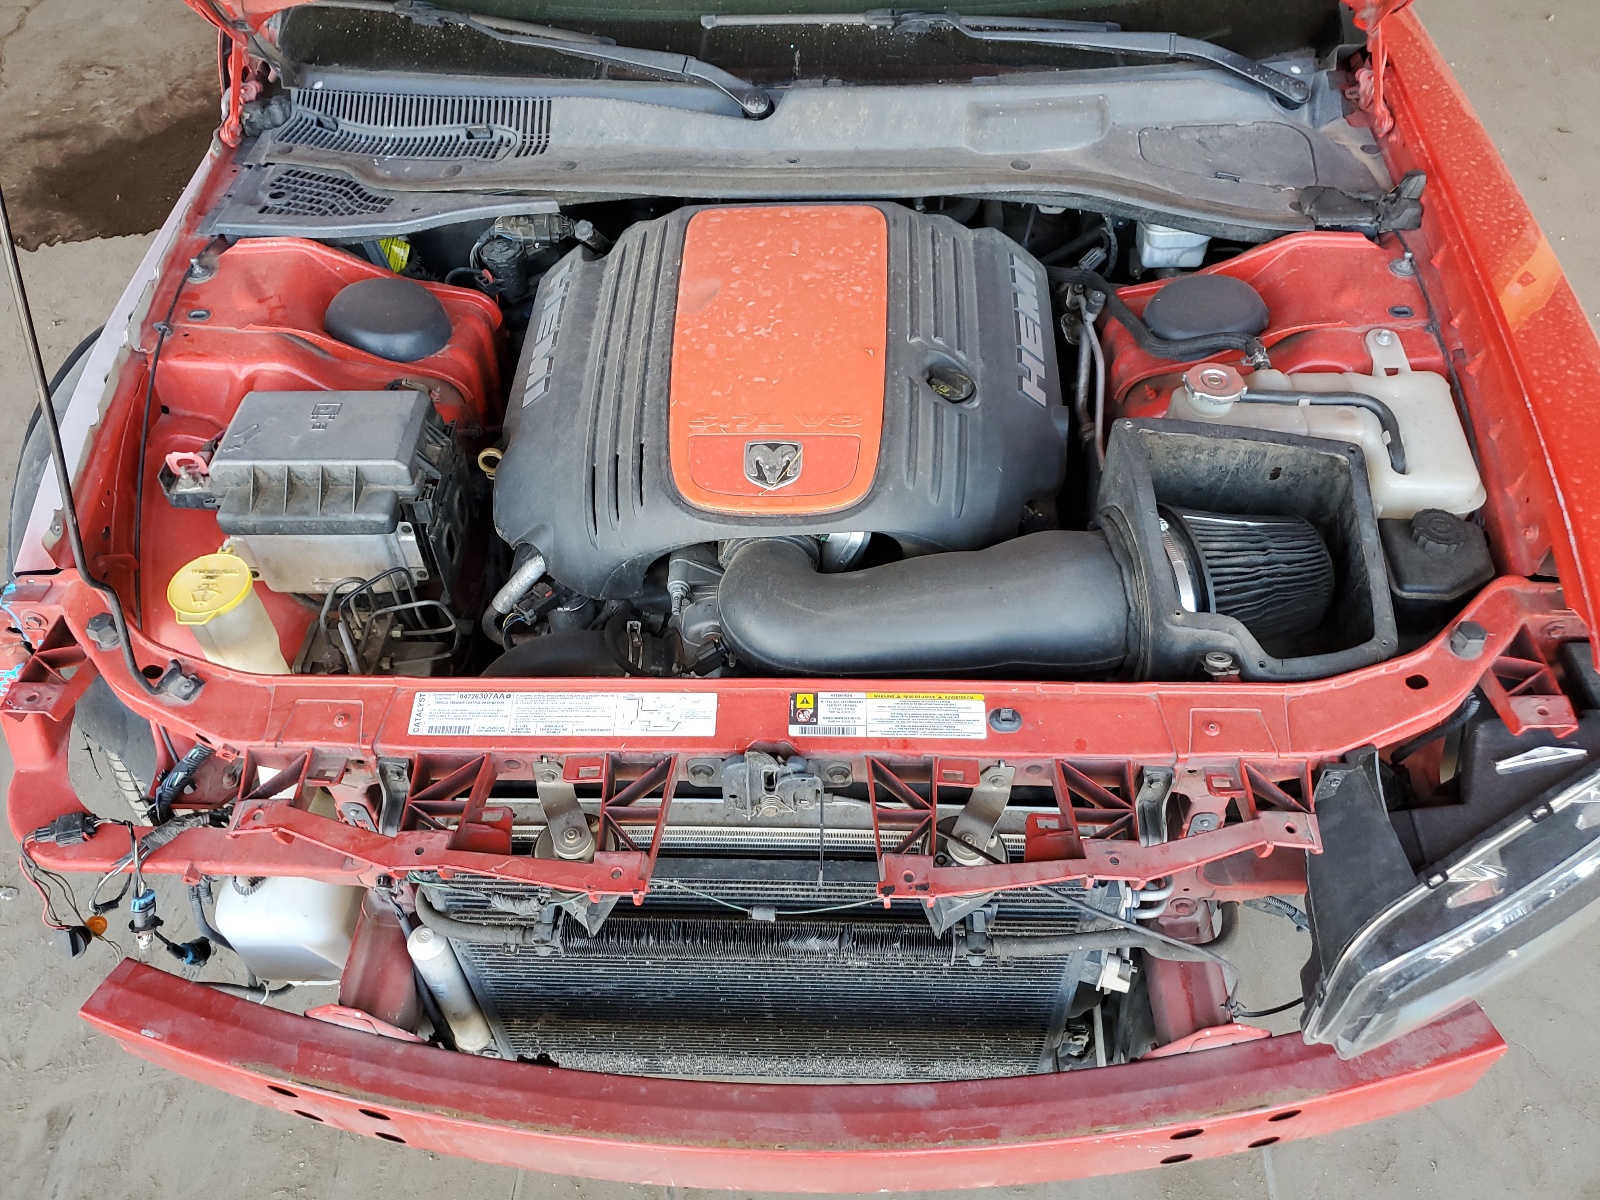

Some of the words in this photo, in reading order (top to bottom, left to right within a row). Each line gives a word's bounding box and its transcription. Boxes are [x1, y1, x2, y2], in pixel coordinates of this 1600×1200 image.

[522, 260, 575, 408] HEMI
[1009, 253, 1047, 407] HEMI
[687, 413, 784, 428] 5.7L
[793, 413, 864, 428] V8
[412, 693, 427, 733] CATALYST
